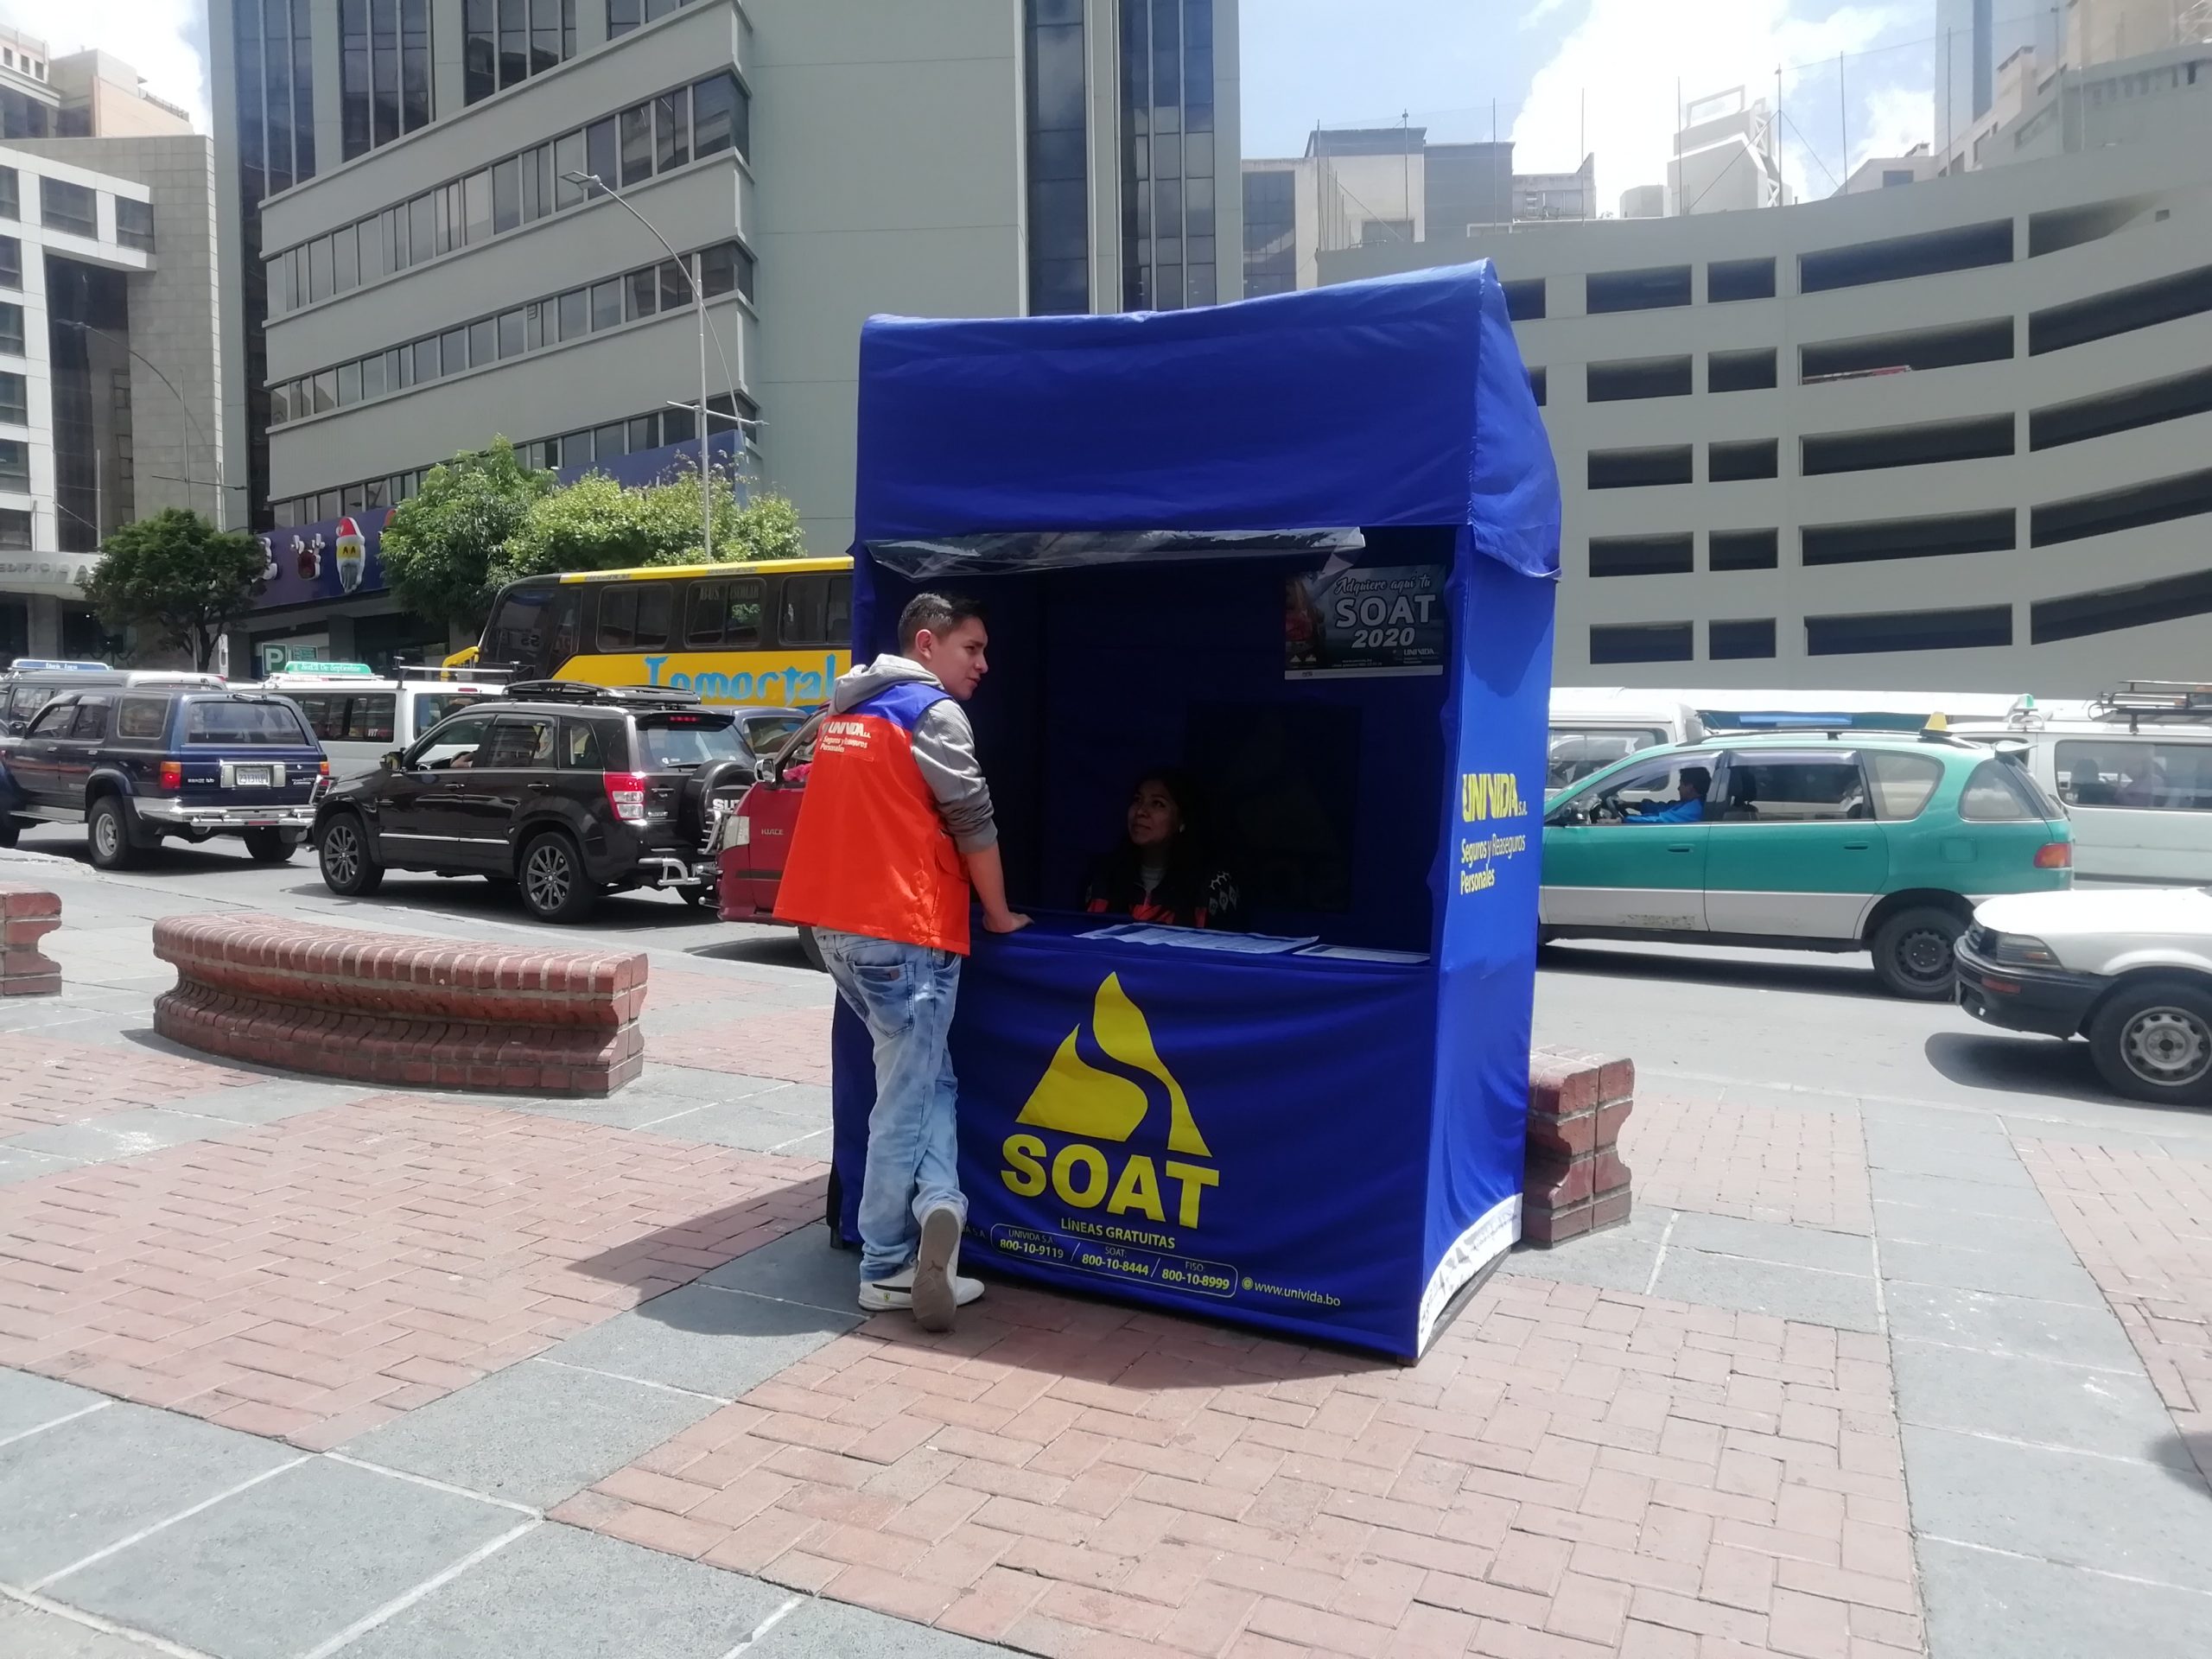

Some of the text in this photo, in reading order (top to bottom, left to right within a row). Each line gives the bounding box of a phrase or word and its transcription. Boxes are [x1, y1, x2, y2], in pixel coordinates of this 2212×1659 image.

[1336, 594, 1436, 627] SOAT
[1351, 627, 1415, 648] 2020
[1461, 838, 1487, 868] Seguros
[1492, 833, 1526, 860] Reaseguros
[1460, 863, 1495, 895] Personales
[1001, 1134, 1219, 1229] SOAT
[1008, 1229, 1040, 1242] UNIVIDA
[1061, 1217, 1176, 1249] LÍNEAS GRATUITAS
[1000, 1238, 1064, 1258] 800-10-9119
[1082, 1254, 1149, 1276] 800-10-8444
[1161, 1268, 1230, 1290] 800-10-8999
[1255, 1282, 1341, 1306] www.univida.bo
